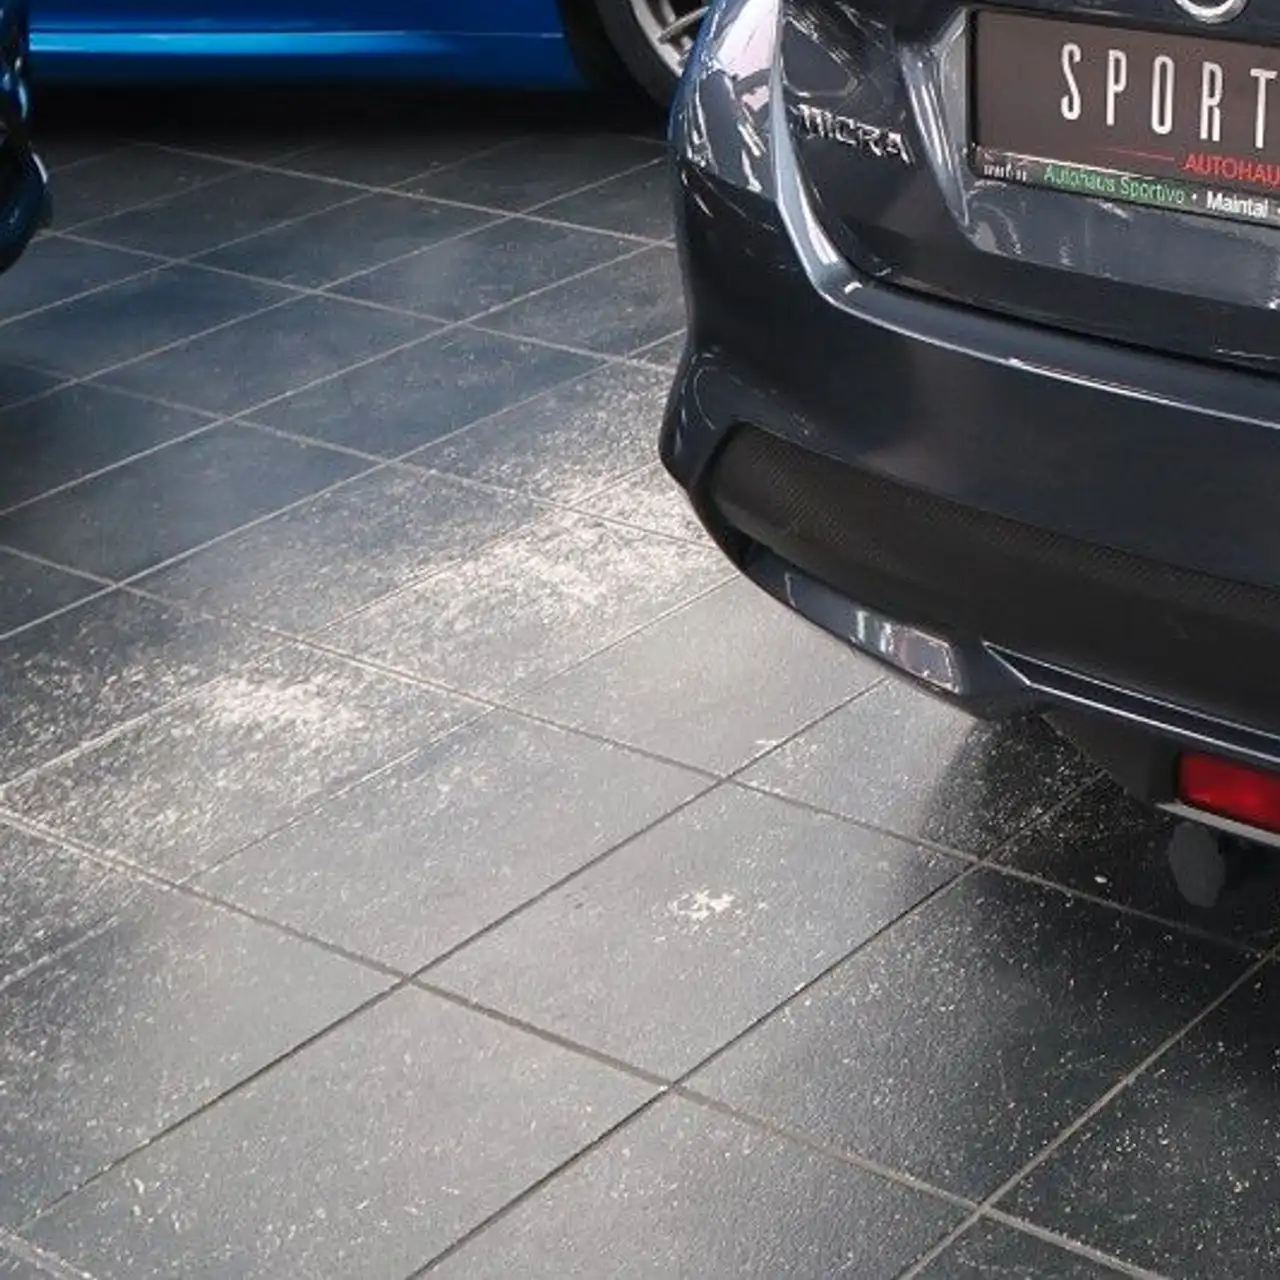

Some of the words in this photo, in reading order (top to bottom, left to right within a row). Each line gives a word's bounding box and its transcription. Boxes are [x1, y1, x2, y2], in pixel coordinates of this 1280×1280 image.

[1043, 166, 1115, 193] Autohaus
[1120, 176, 1186, 205] Sportivo
[1206, 190, 1269, 219] Maintal
